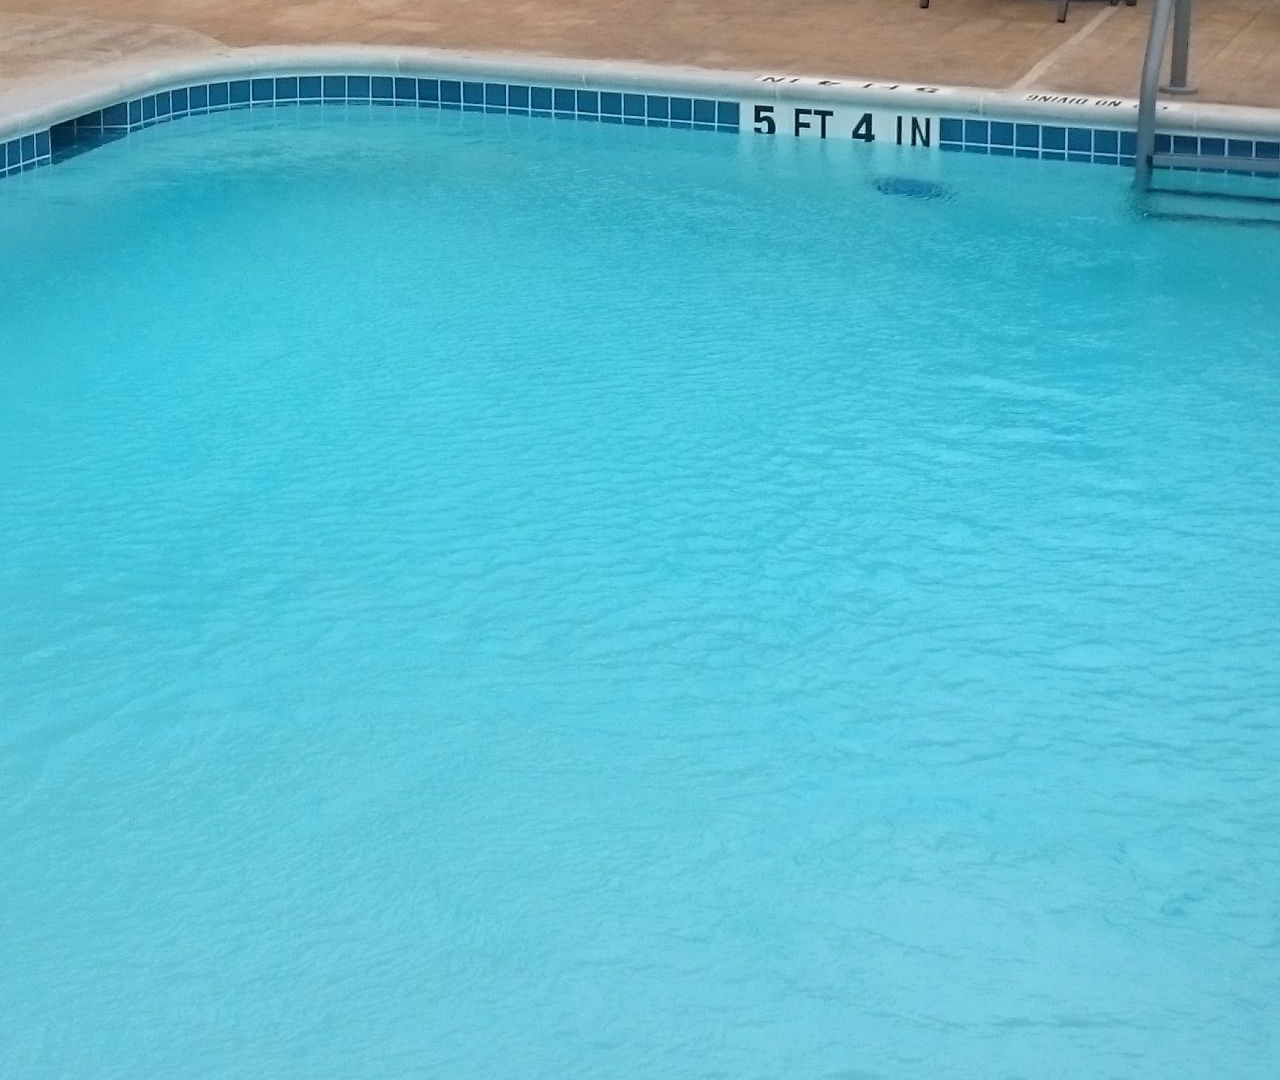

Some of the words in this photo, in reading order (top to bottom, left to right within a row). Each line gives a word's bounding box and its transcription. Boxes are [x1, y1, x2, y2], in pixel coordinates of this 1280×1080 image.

[1025, 94, 1089, 104] DIVING
[753, 105, 776, 135] 5
[794, 108, 835, 139] FT
[851, 113, 875, 143] 4
[896, 115, 931, 148] IN
